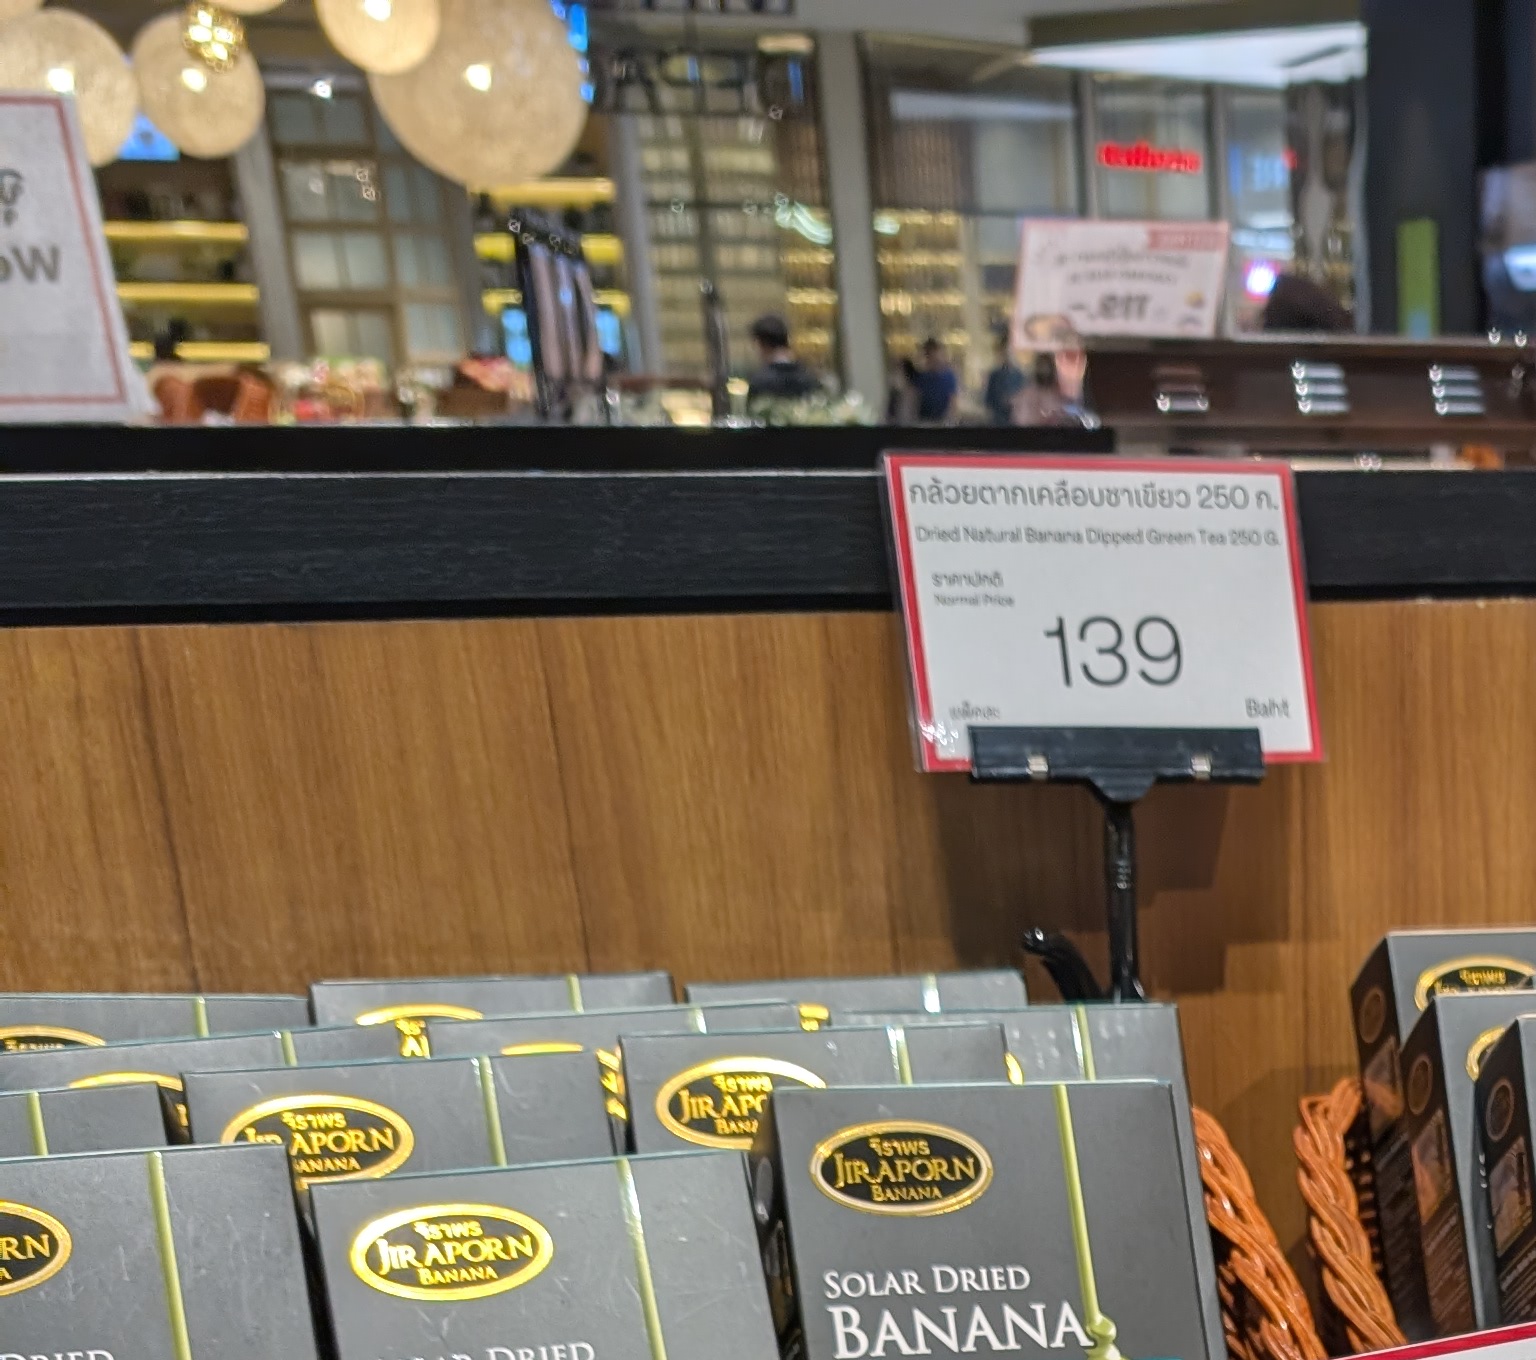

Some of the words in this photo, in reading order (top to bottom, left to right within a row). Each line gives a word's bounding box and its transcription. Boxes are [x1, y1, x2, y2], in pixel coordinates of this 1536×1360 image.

[1197, 484, 1249, 510] 250
[915, 525, 960, 543] Dried
[963, 525, 1022, 544] Natural
[1026, 527, 1082, 545] Banana
[1085, 527, 1144, 549] Dipped
[1146, 528, 1195, 546] Green
[1198, 528, 1226, 547] Tea
[1229, 529, 1261, 547] 250
[1044, 615, 1183, 688] 139
[1245, 697, 1291, 719] Baht
